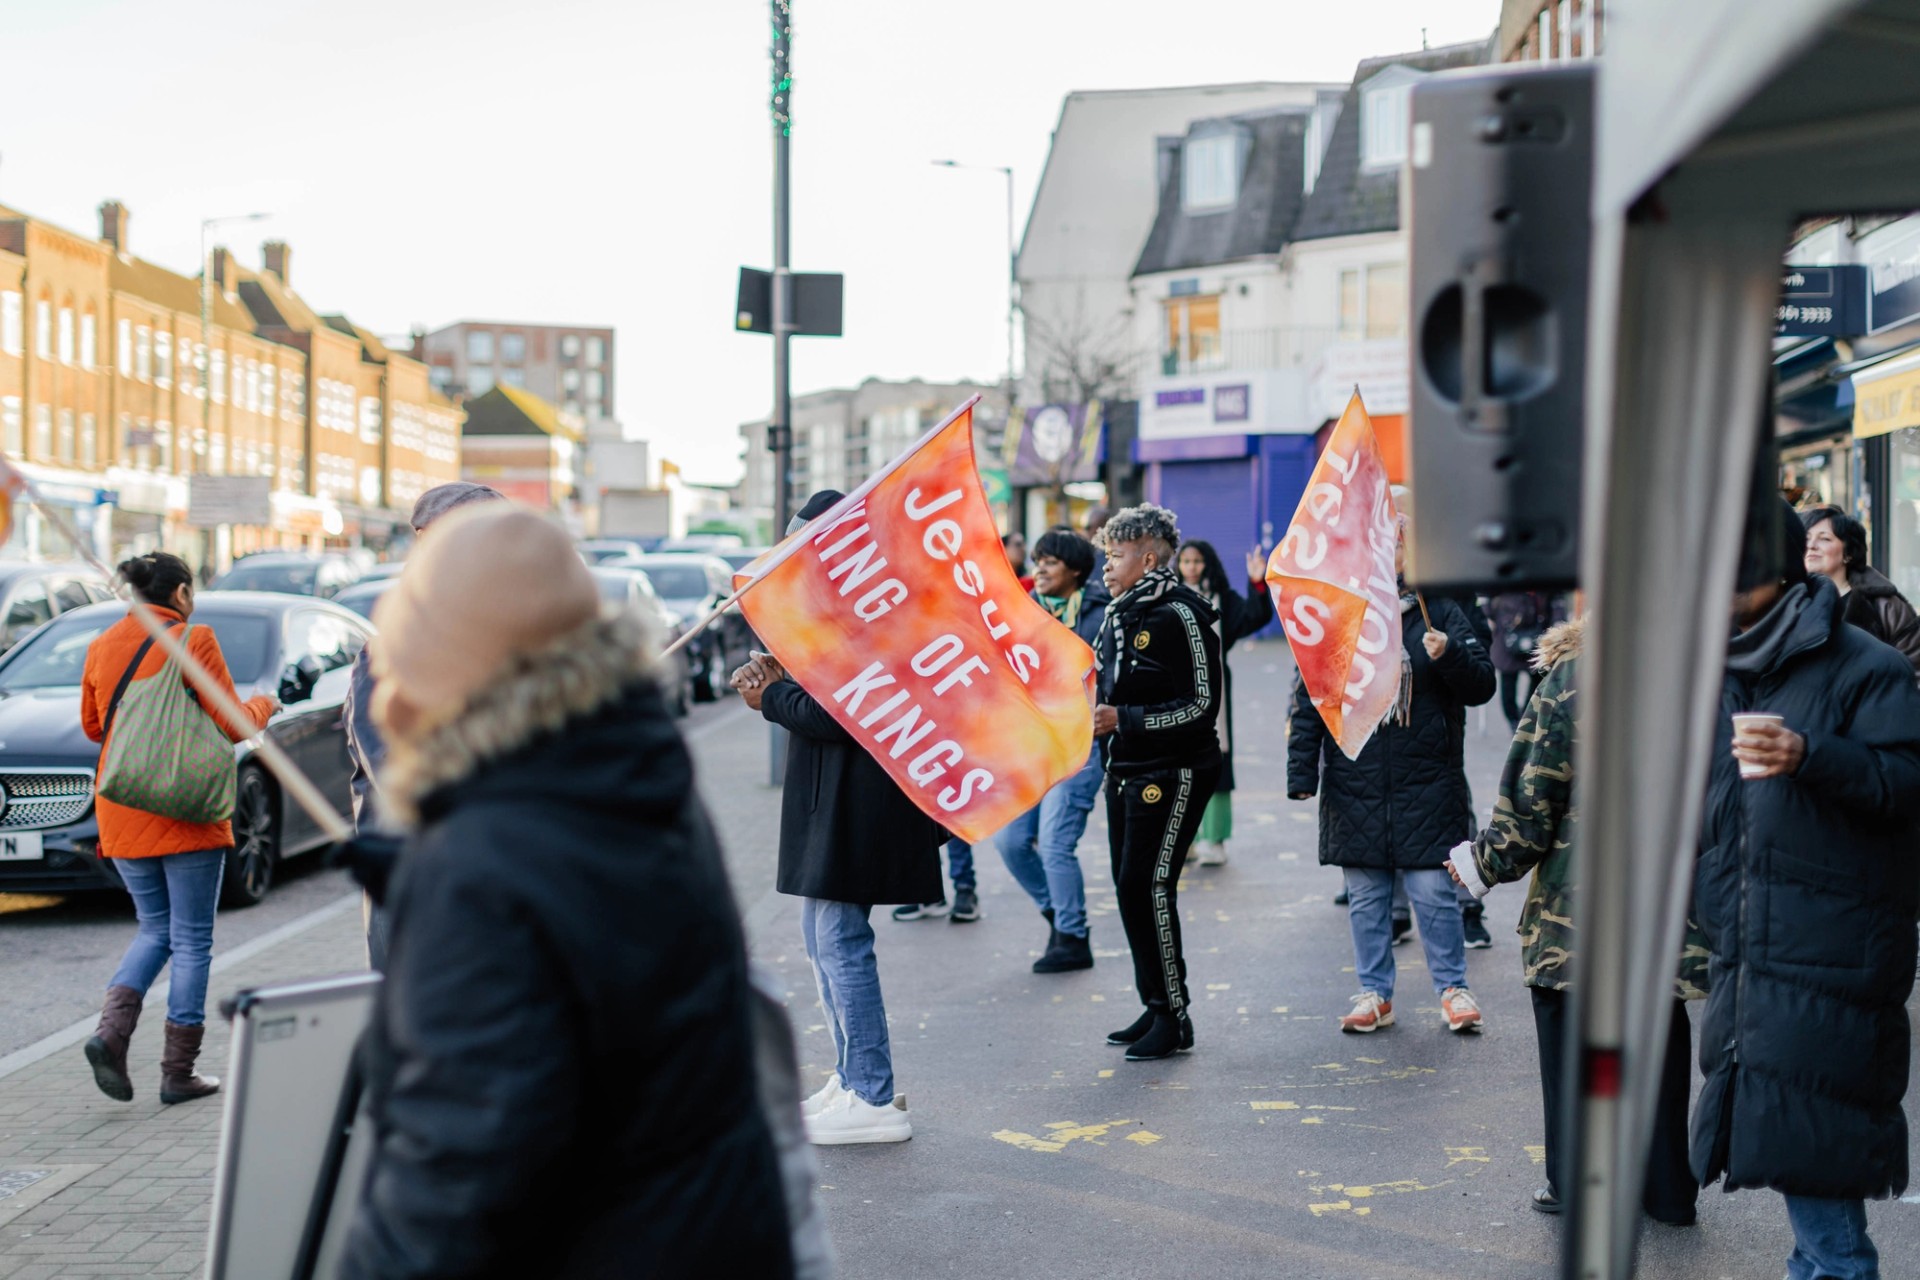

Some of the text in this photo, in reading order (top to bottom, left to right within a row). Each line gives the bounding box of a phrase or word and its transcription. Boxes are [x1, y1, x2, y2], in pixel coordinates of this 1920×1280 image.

[814, 498, 990, 697] KING OF
[904, 486, 1040, 685] Jesus
[832, 660, 995, 812] KINGS
